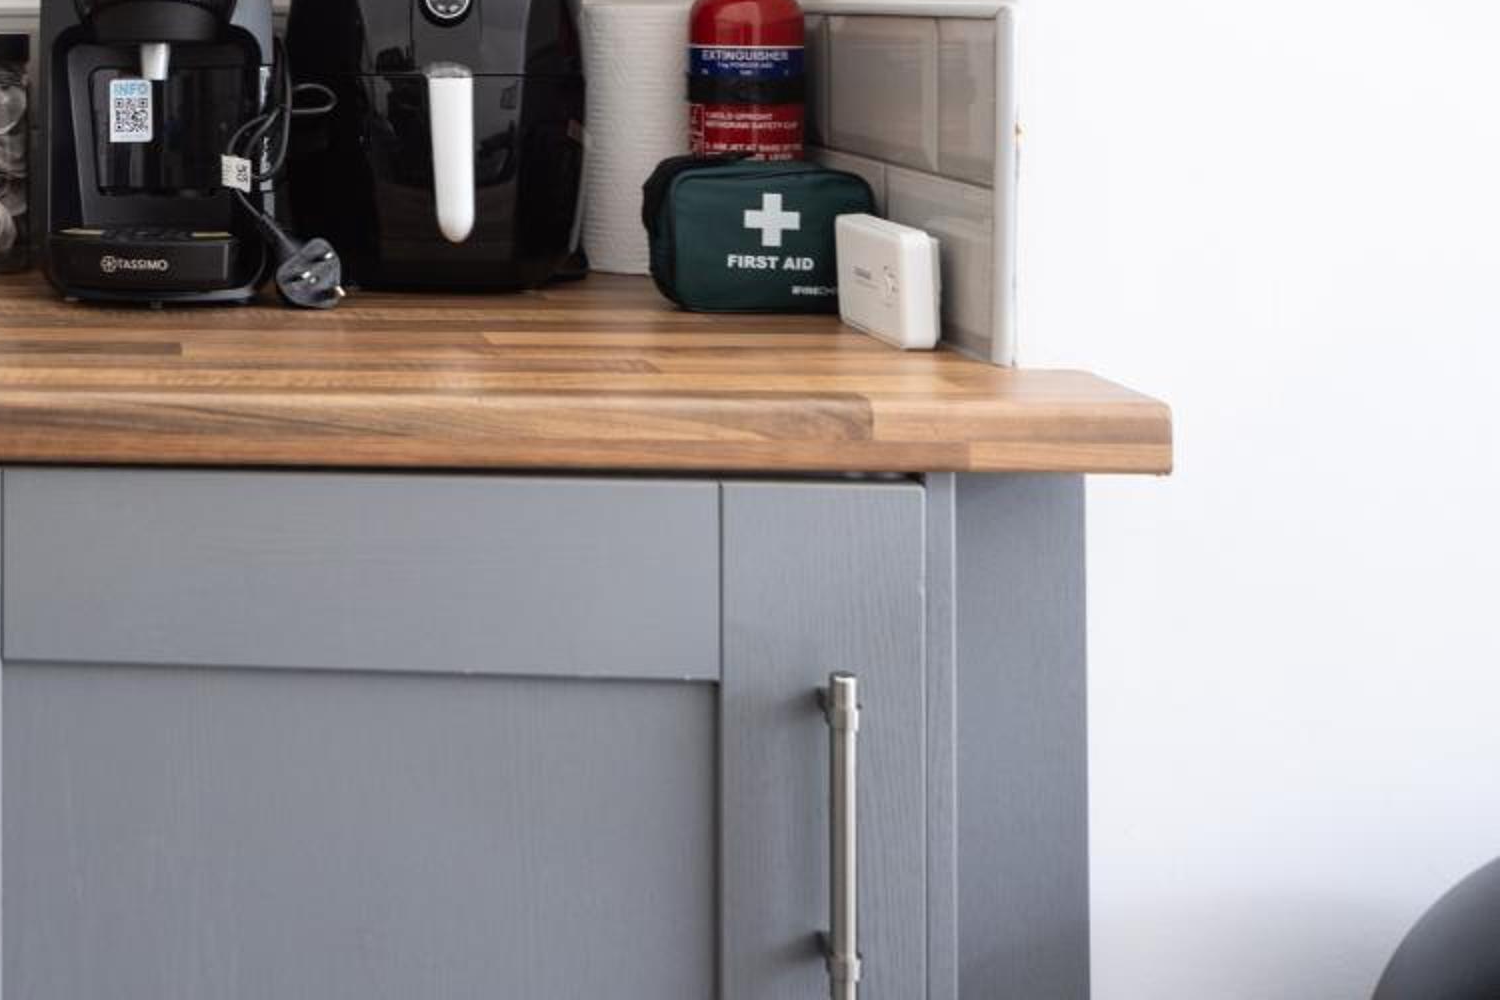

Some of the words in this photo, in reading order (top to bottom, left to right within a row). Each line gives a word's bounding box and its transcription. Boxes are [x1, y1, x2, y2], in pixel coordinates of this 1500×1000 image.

[702, 50, 788, 61] EXTINGUISHER
[115, 84, 148, 96] INFO
[117, 259, 168, 271] TASSIMO
[727, 254, 779, 269] FIRST
[782, 257, 815, 270] AID
